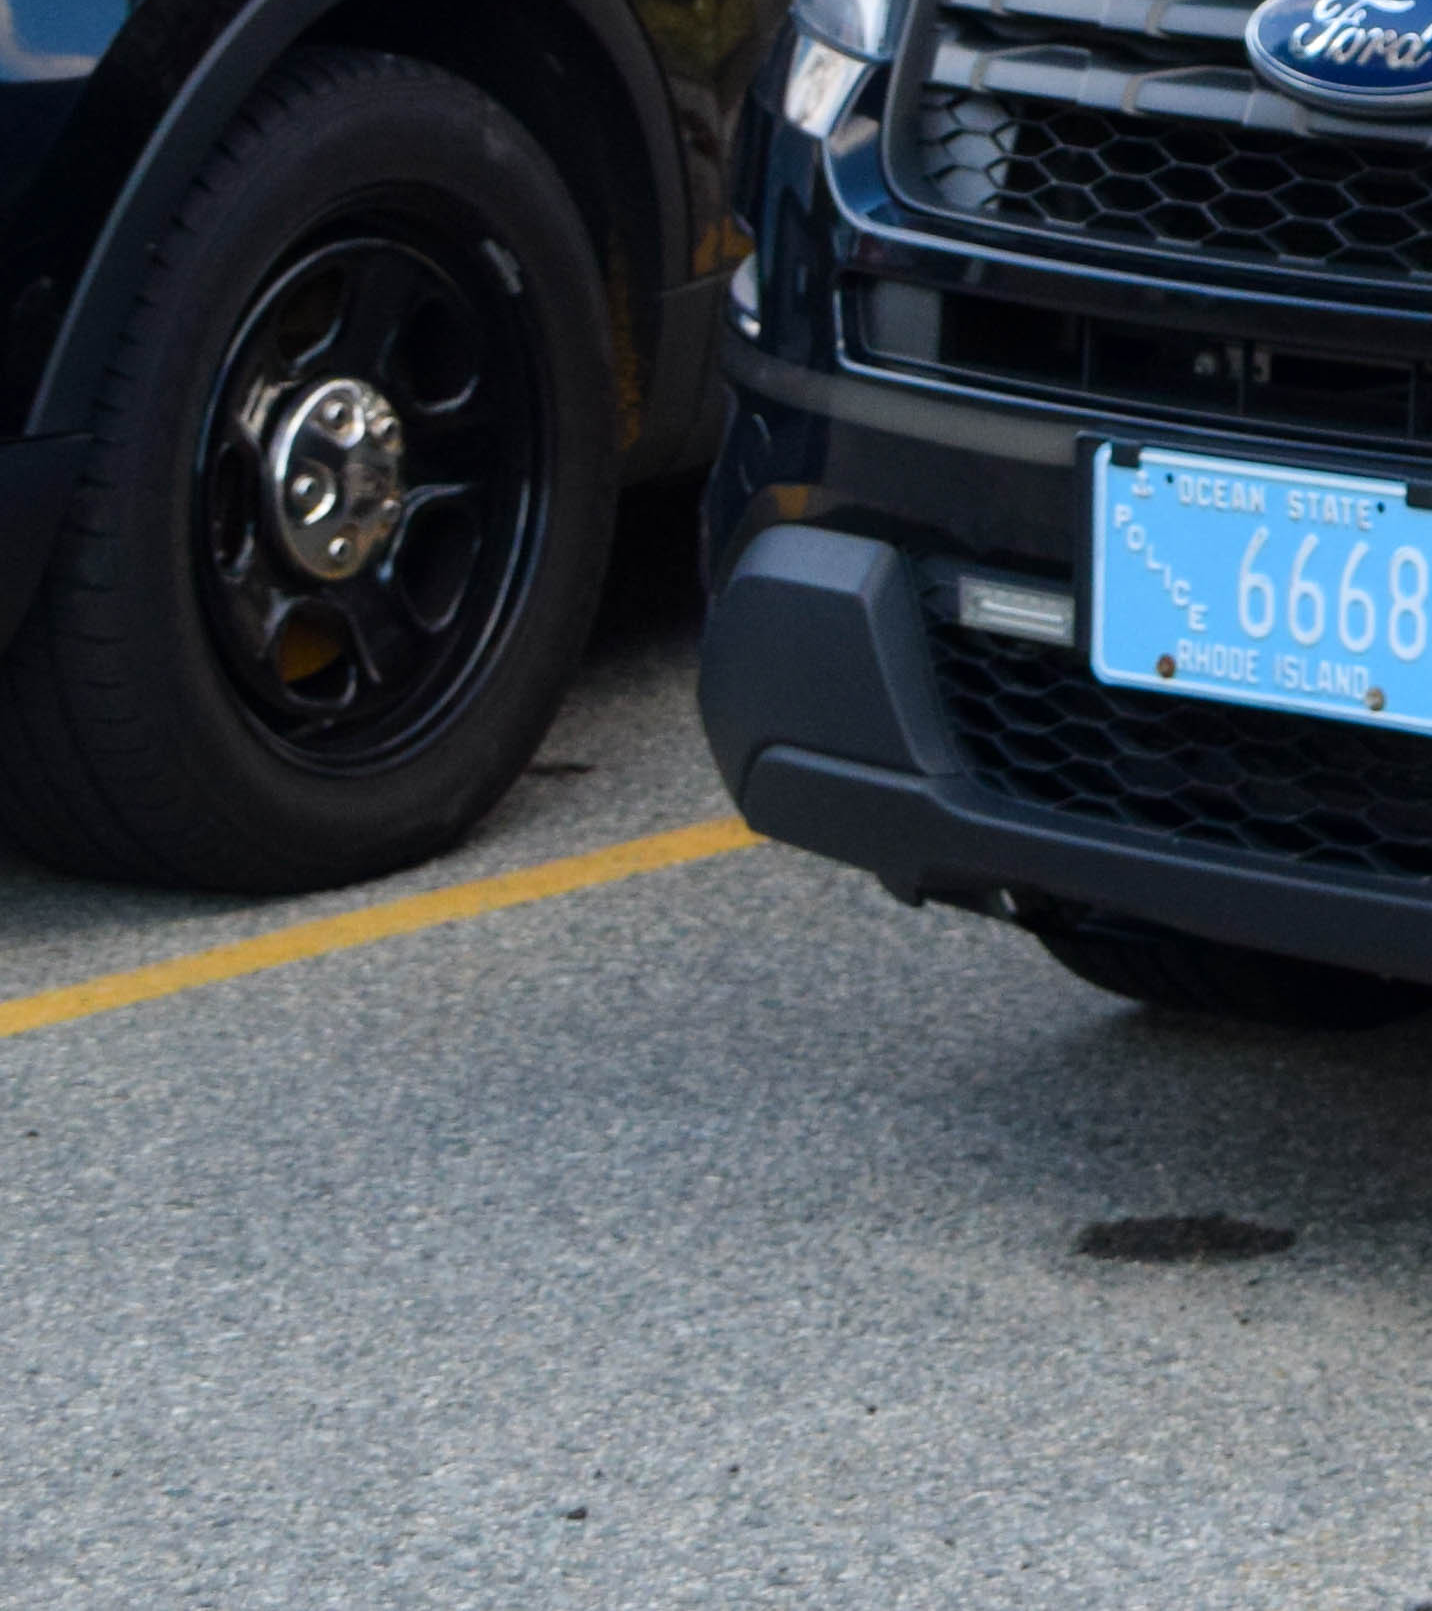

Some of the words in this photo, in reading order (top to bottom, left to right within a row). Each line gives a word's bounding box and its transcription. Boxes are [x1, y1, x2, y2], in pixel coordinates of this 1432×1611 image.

[1178, 474, 1267, 515] OCEAN
[1287, 489, 1375, 531] STATE
[1112, 503, 1209, 632] POLICE
[1237, 525, 1430, 662] 6668
[1176, 638, 1260, 685] RHODE
[1274, 655, 1372, 700] ISLAND
